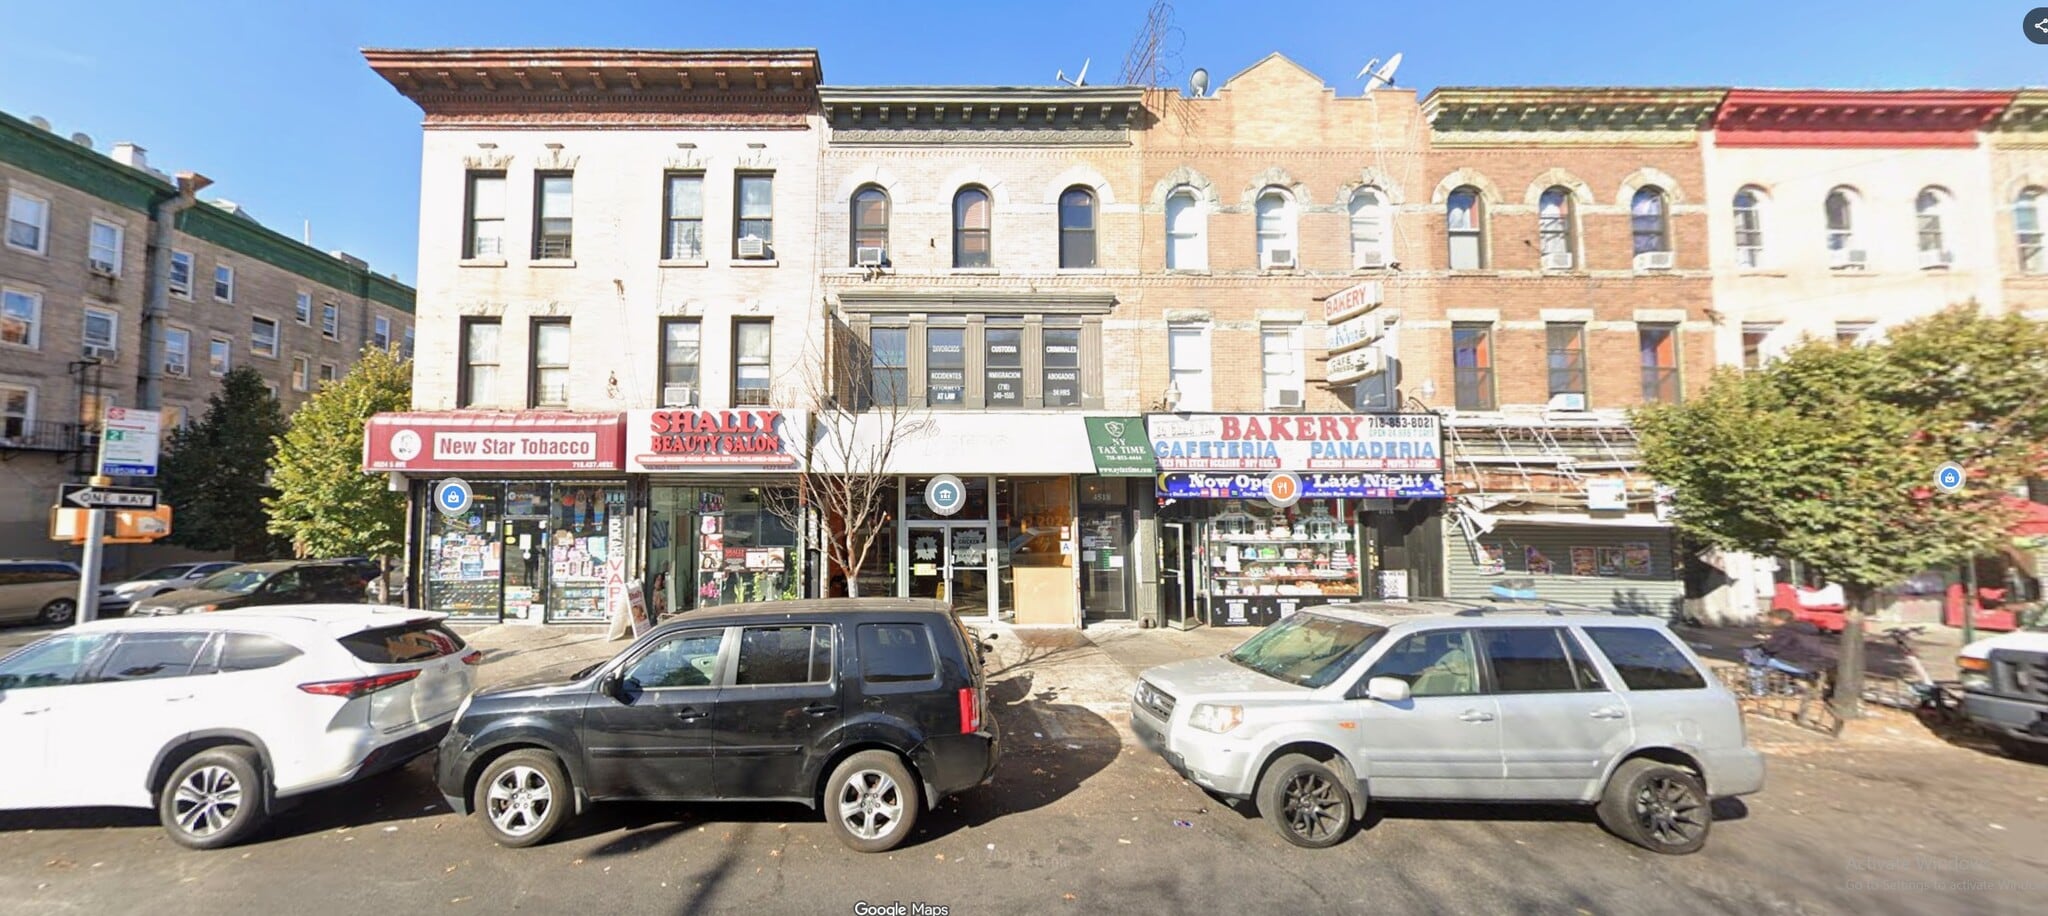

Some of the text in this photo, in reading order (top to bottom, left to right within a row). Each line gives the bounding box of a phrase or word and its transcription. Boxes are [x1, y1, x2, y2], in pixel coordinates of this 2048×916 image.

[1325, 286, 1366, 317] BAKERY
[991, 345, 1017, 353] CUSTODIA
[1046, 345, 1077, 353] CRIMINALES
[931, 372, 962, 380] ACCIDENTES
[1047, 372, 1076, 380] ABOGADOS
[651, 410, 780, 434] SHALLY
[1220, 416, 1364, 441] BAKERY
[1368, 417, 1434, 428] 718-853-8021
[440, 438, 590, 455] New Star Tobacco
[651, 435, 780, 452] BEAUTY SALON
[1097, 446, 1146, 454] TAX TIME
[1112, 438, 1126, 446] NY
[1155, 440, 1278, 459] CAFETERIA
[1310, 441, 1436, 459] PANADERIA
[1188, 474, 1270, 490] Now Ope
[1313, 473, 1423, 490] Late Night
[80, 491, 146, 503] ONE WAY
[609, 559, 624, 613] VAPE
